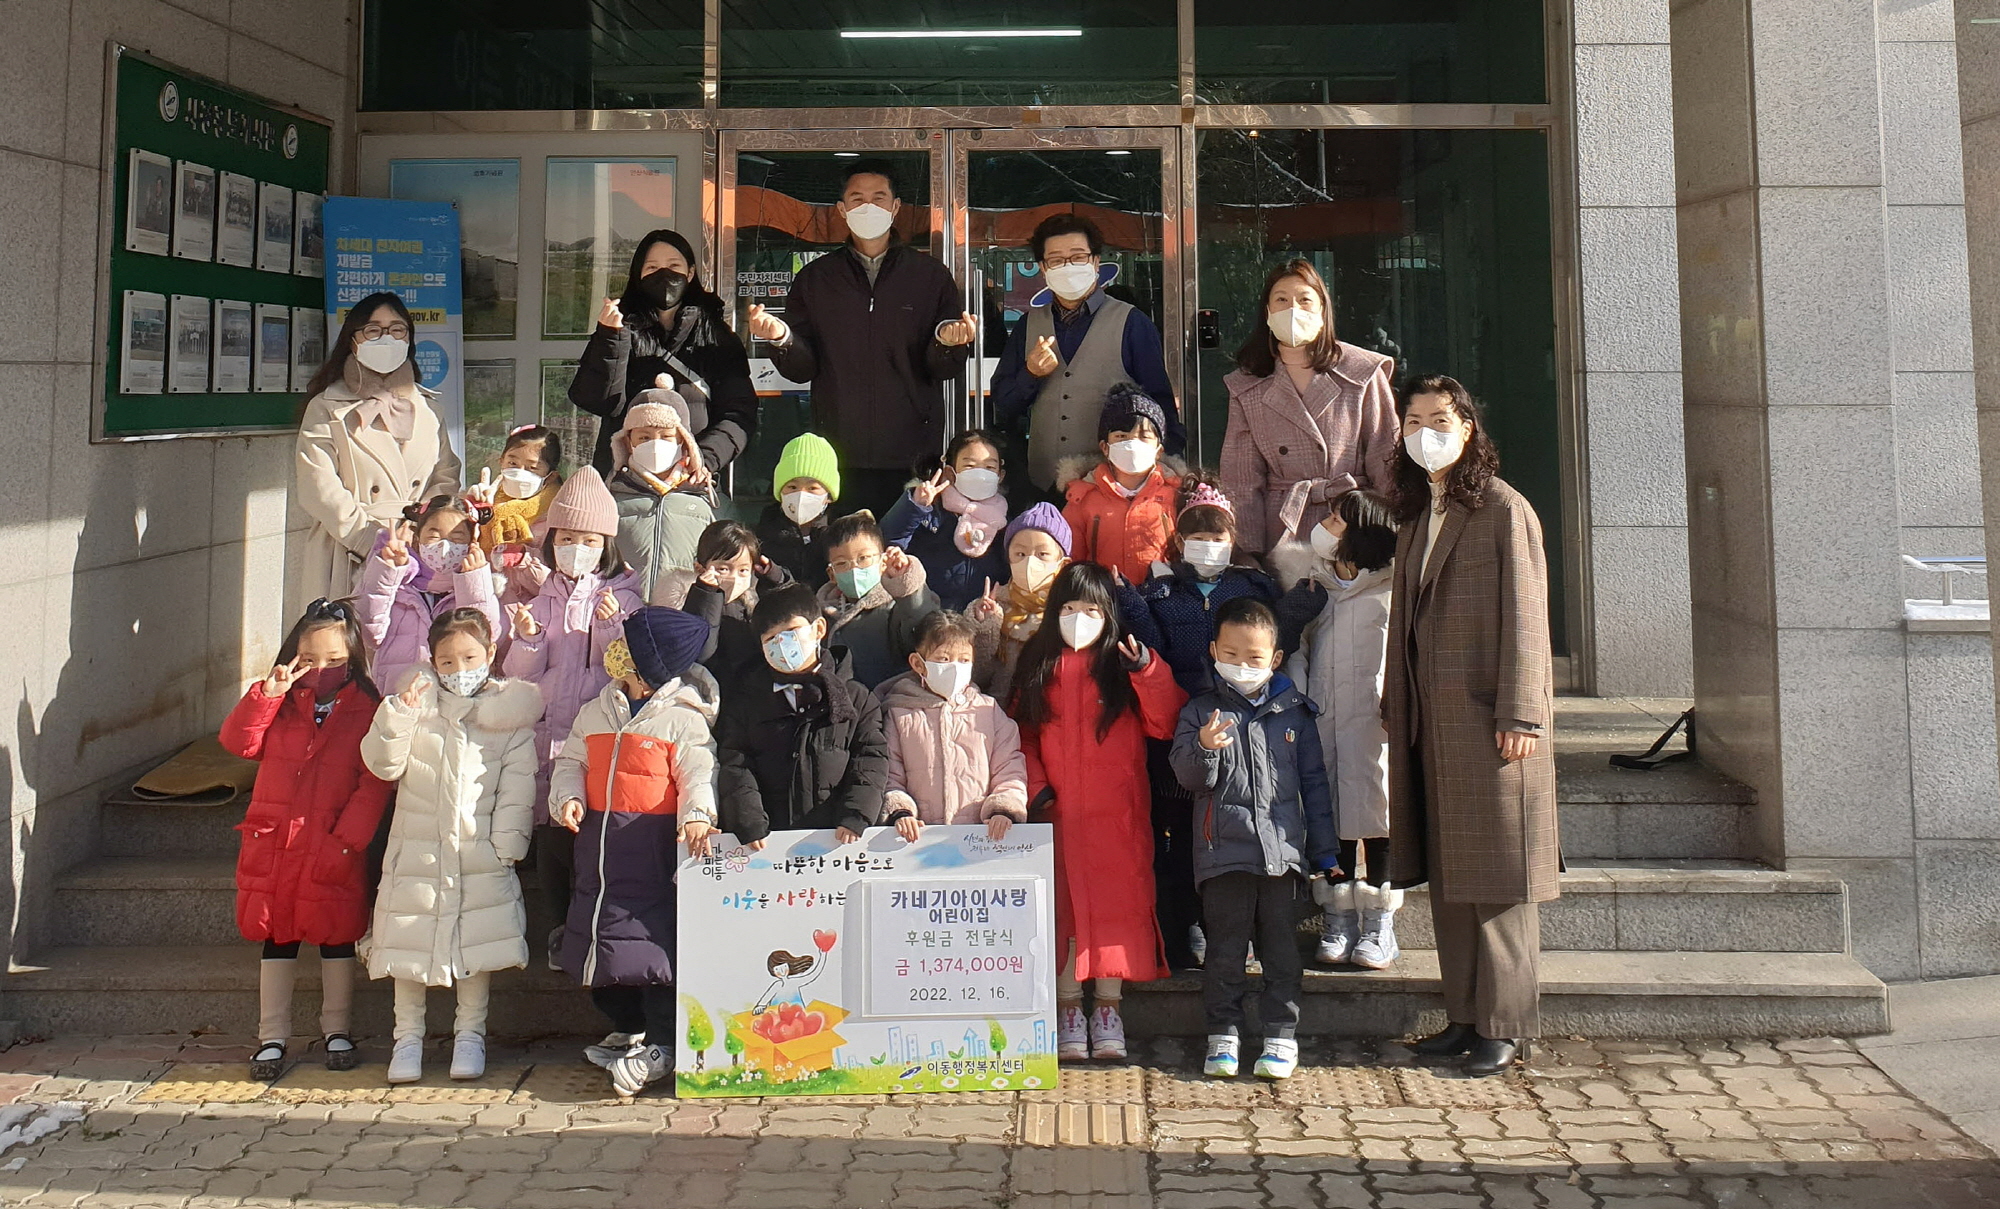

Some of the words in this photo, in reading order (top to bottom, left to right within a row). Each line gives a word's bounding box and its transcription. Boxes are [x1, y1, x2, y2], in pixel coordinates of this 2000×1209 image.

[336, 254, 373, 269] 재발급
[336, 271, 385, 286] 간편하게
[738, 272, 791, 283] 주민자치센터
[738, 286, 767, 297] 표시된
[704, 854, 724, 866] 피는
[773, 854, 826, 875] 따뜻한
[832, 852, 895, 873] 마음으로
[702, 866, 727, 881] 이동
[722, 889, 769, 910] 이웃을
[776, 887, 847, 907] 사랑하는
[891, 888, 1028, 909] 카네기아이사랑
[929, 907, 989, 924] 어린이집
[905, 930, 953, 948] 후원금
[965, 928, 1013, 947] 전달식
[895, 959, 910, 976] 금
[919, 955, 1023, 976] 1,374,000원
[909, 987, 952, 1002] 2022.
[960, 986, 981, 1001] 12.
[989, 985, 1010, 1000] 16.
[926, 1059, 1026, 1076] 이동행정복지센터
